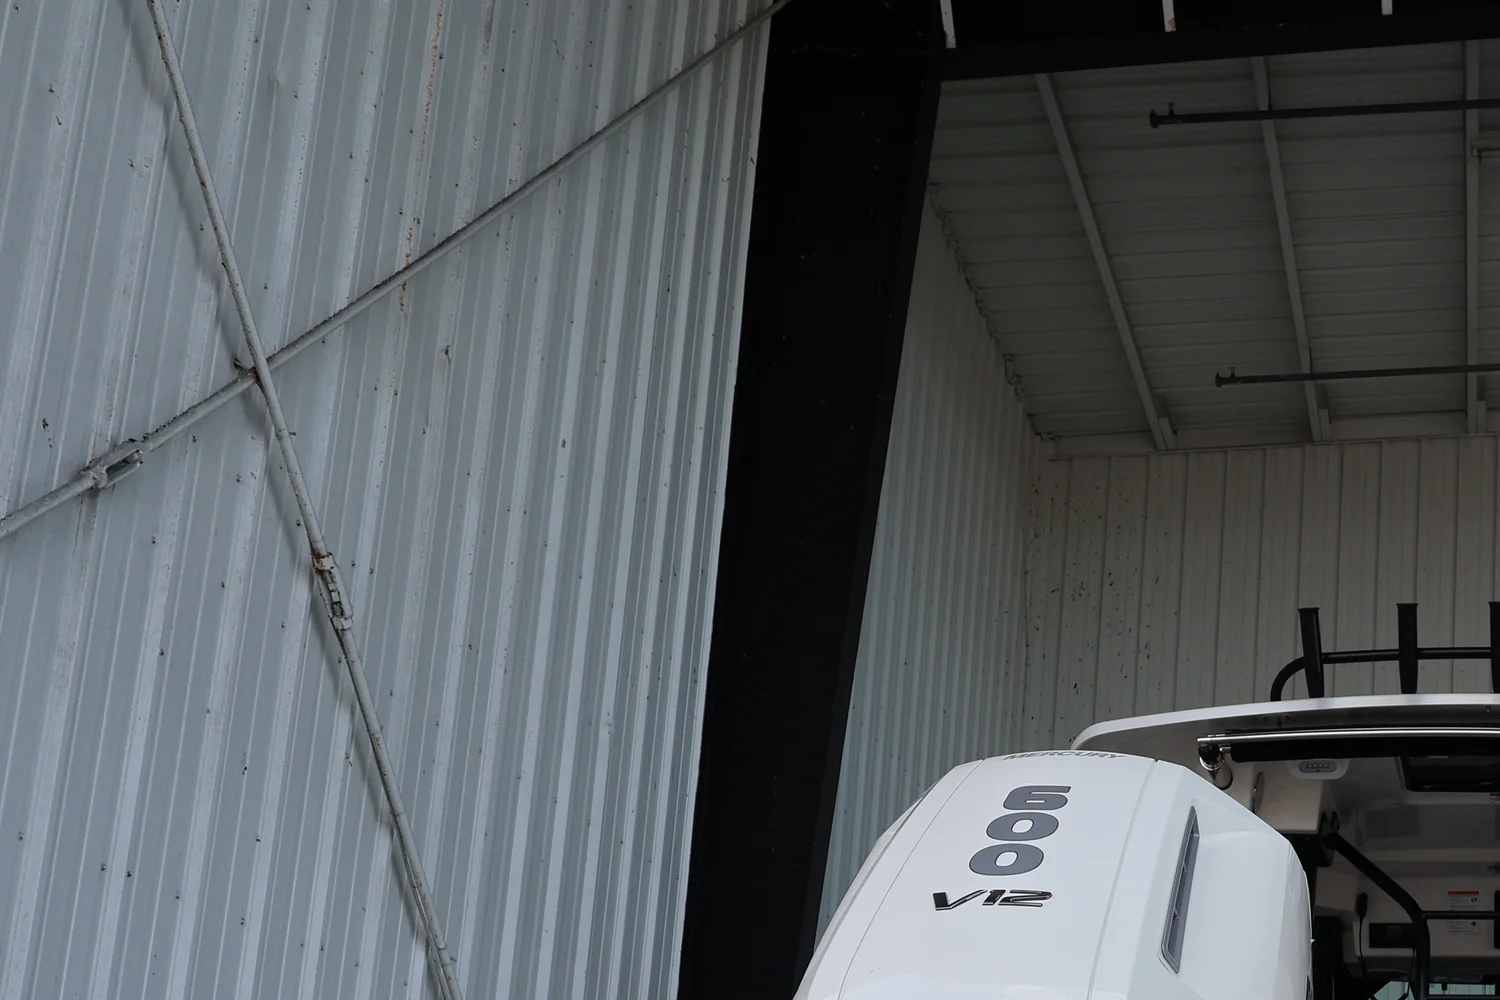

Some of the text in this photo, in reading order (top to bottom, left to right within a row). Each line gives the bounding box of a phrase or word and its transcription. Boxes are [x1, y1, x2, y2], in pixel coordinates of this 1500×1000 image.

[1002, 751, 1127, 761] MERCURY
[968, 785, 1072, 876] 600
[932, 889, 1053, 911] V12
